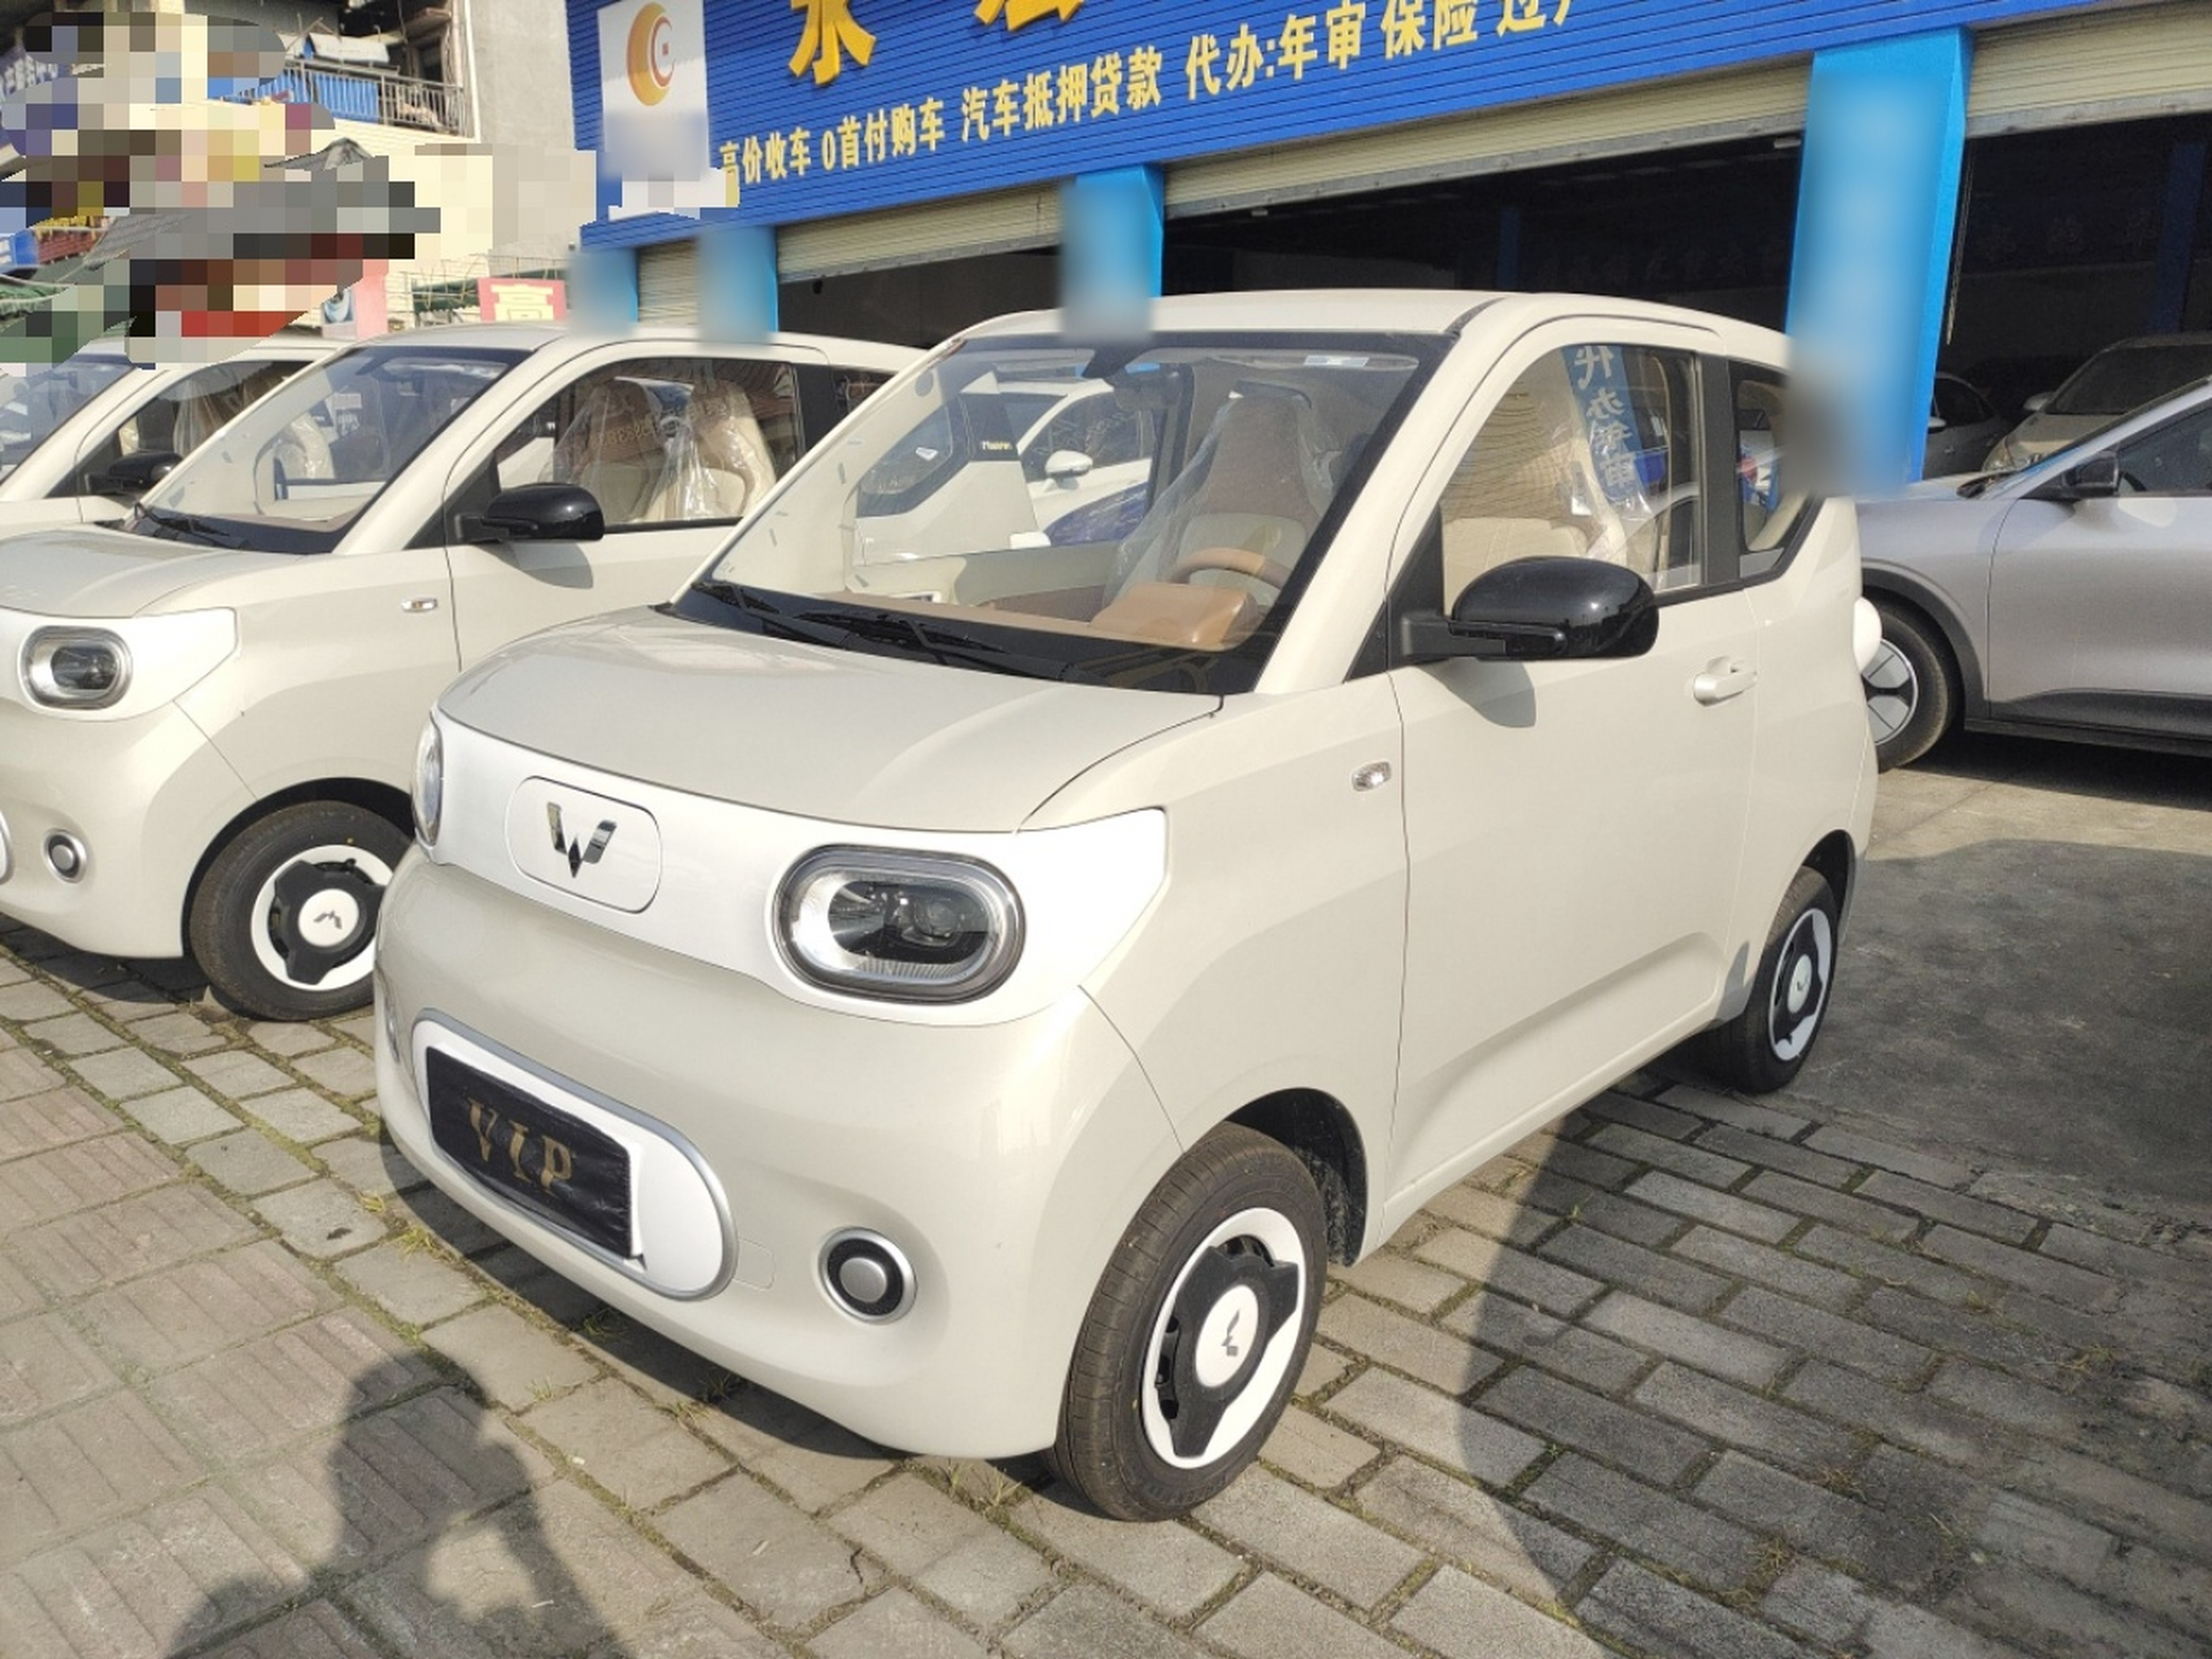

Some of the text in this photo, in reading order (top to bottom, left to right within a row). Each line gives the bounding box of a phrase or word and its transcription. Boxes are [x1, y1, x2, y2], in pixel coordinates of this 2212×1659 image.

[822, 99, 945, 171] 0首付购车
[961, 46, 1162, 142] 汽车抵押贷款
[1380, 0, 1478, 59] 保险
[467, 1097, 572, 1196] VIP
